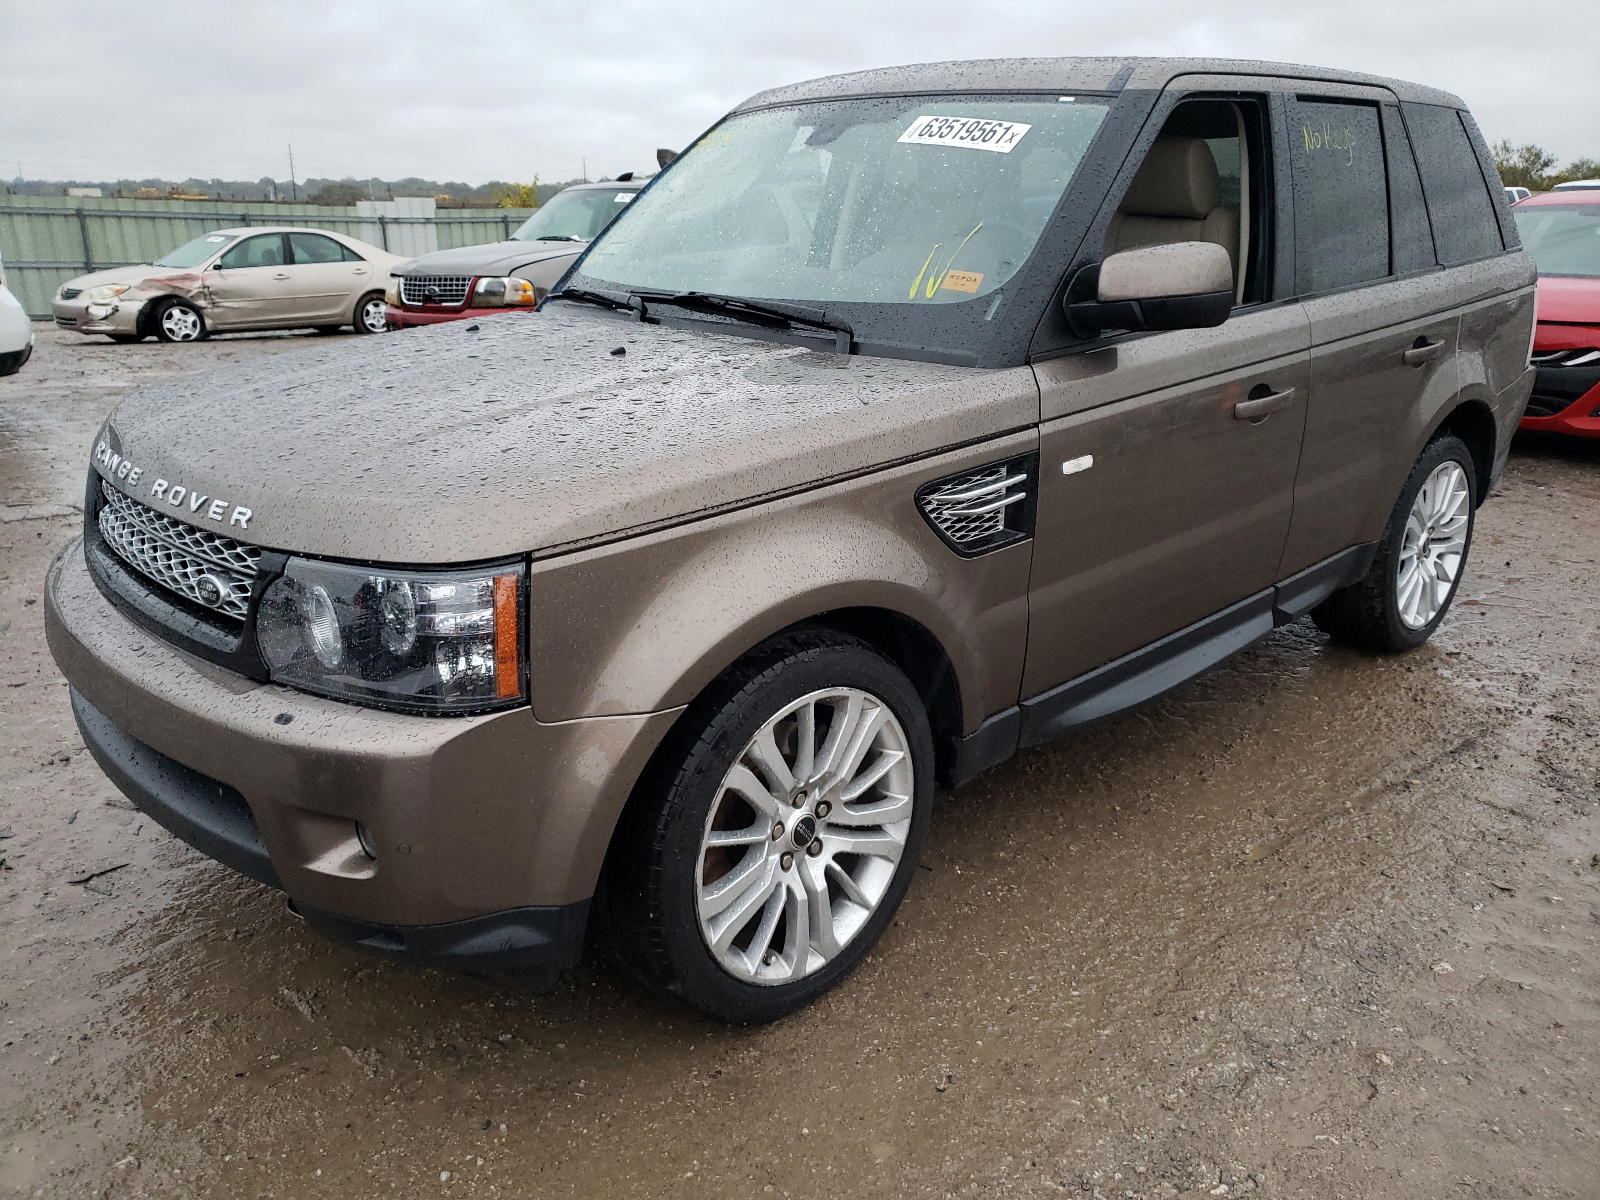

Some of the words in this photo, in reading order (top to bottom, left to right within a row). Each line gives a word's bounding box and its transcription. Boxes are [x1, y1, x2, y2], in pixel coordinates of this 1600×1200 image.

[918, 117, 1014, 144] 63519561
[95, 440, 144, 486] RANGE
[151, 478, 253, 529] ROVER
